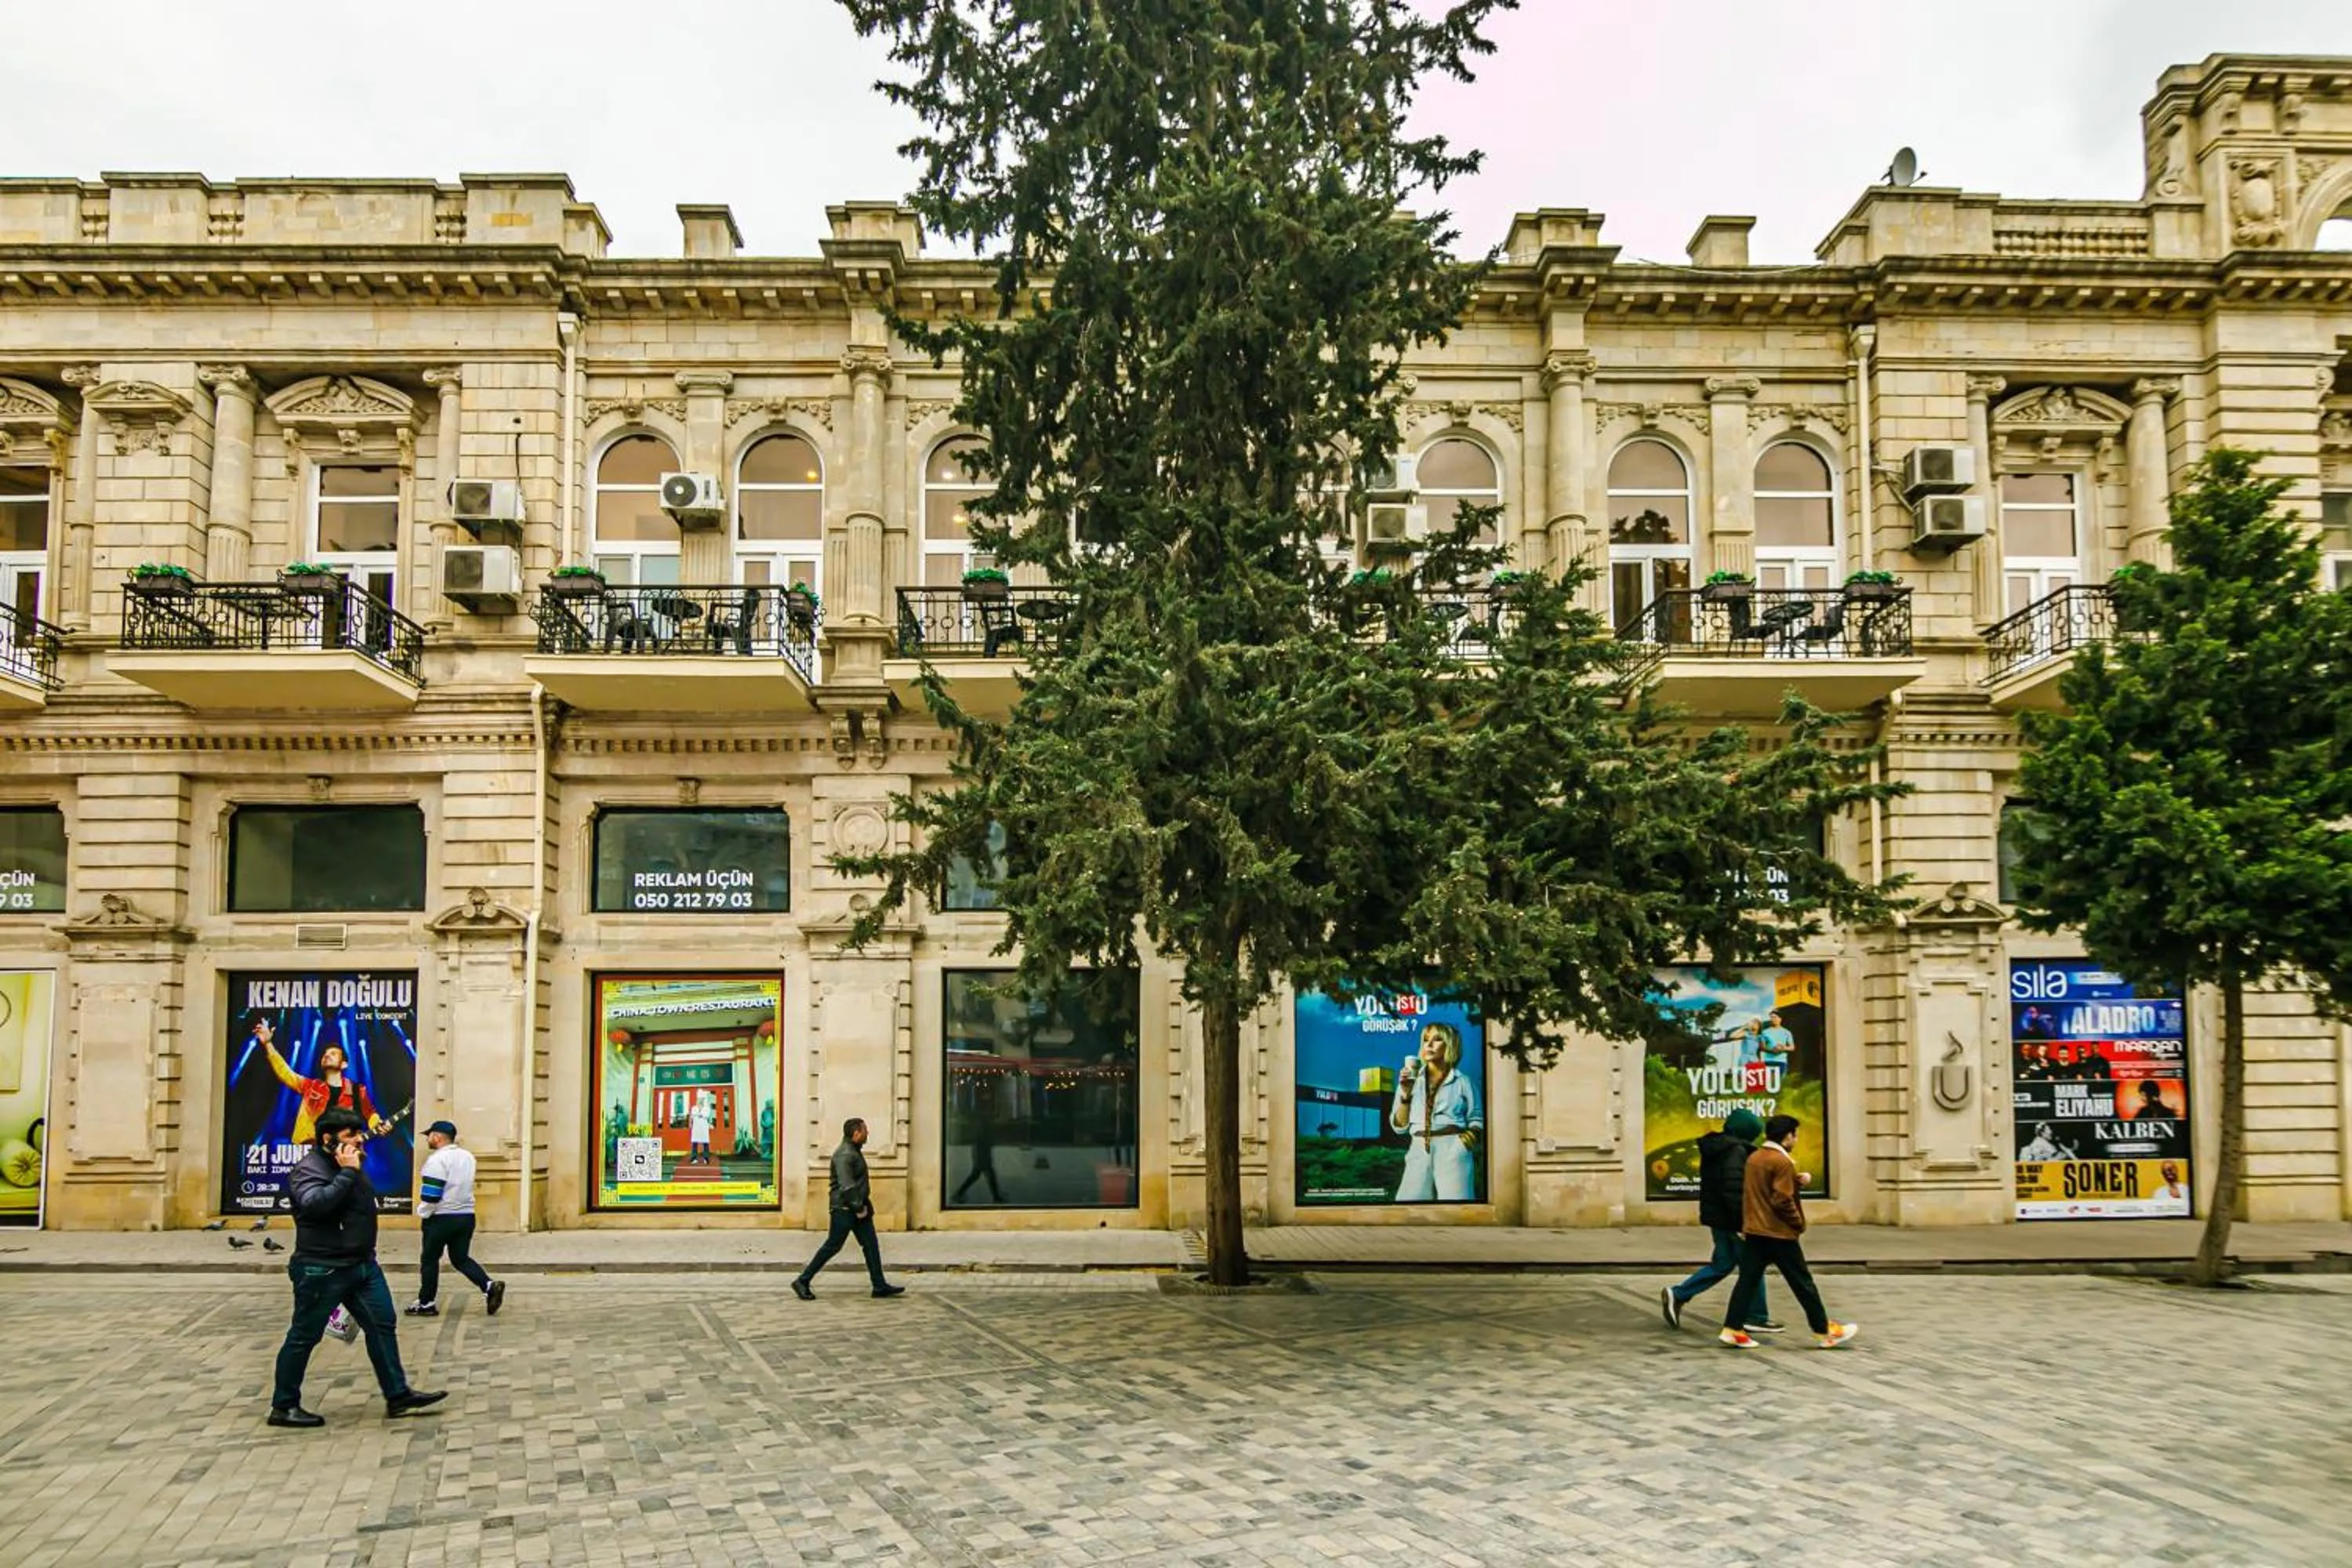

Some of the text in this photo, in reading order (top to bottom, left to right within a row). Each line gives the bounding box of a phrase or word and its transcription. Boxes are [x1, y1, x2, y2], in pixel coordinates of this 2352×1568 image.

[634, 869, 753, 890] REKLAM ÜÇÜN
[12, 893, 34, 909] 03
[634, 892, 753, 908] 050 212 79 03
[249, 974, 412, 1007] KENAN DOĞULU
[2095, 1122, 2175, 1139] KALBEN
[246, 1144, 267, 1164] 21
[2063, 1161, 2138, 1199] SONER
